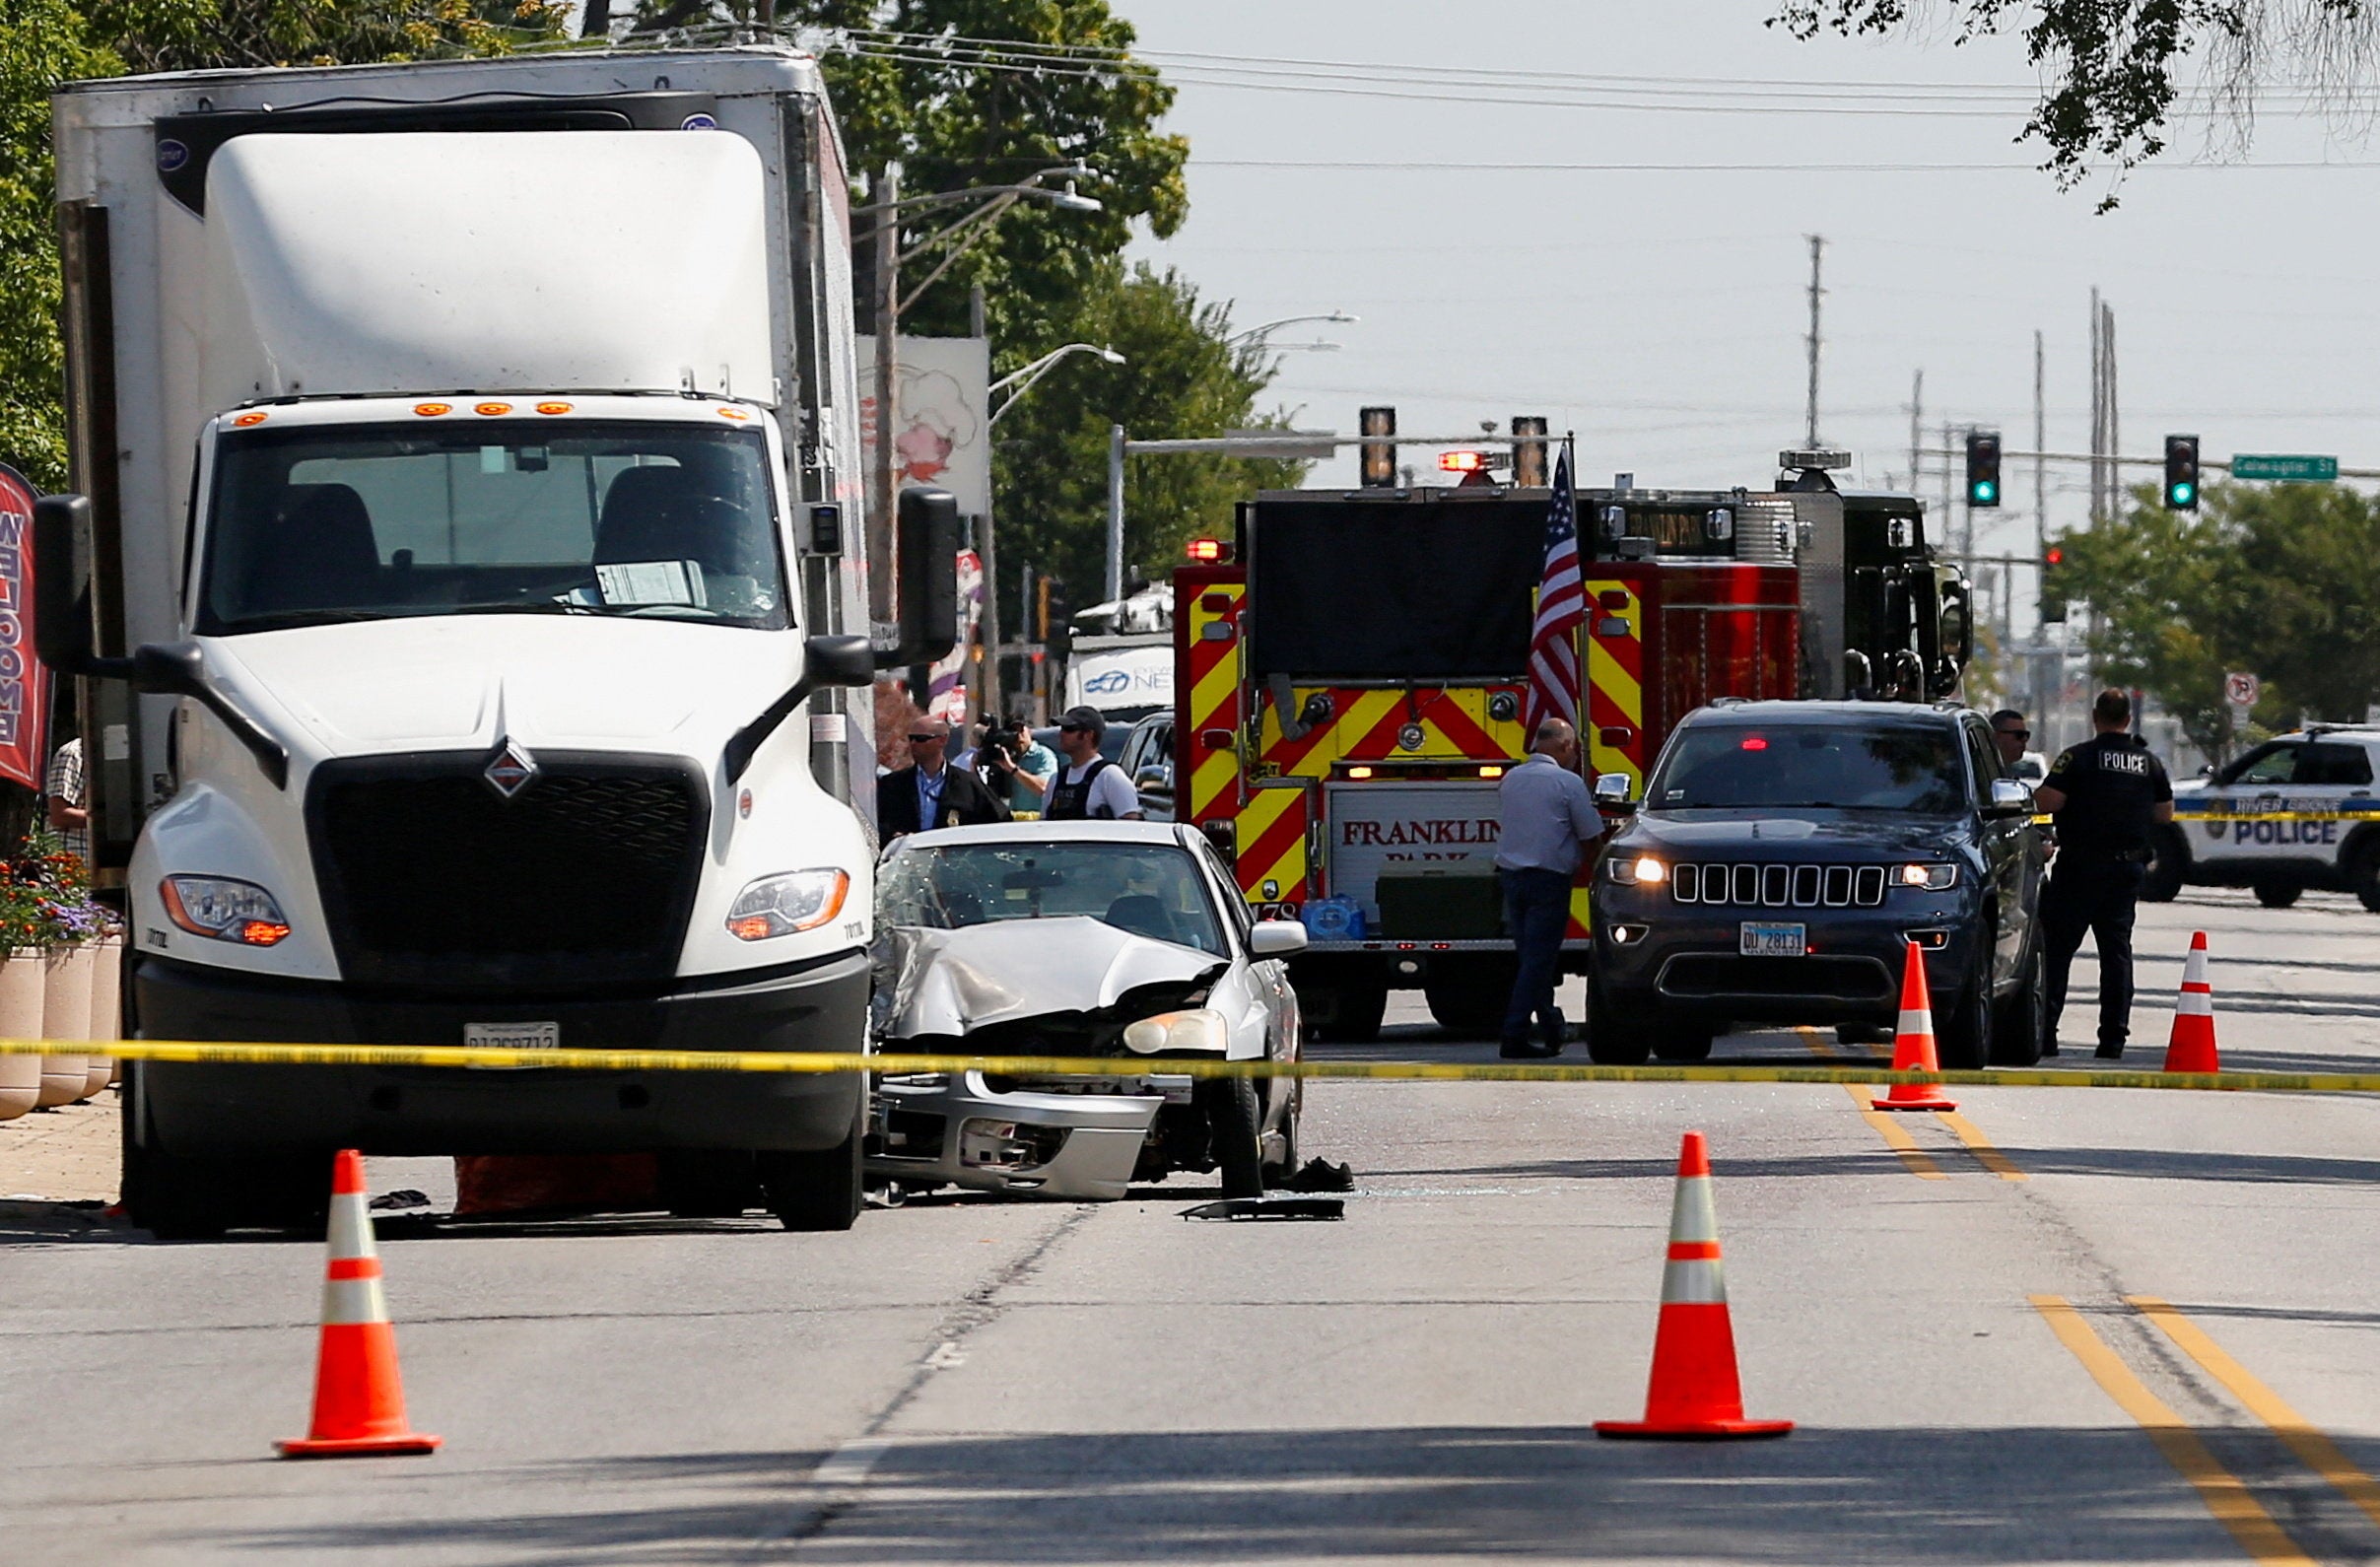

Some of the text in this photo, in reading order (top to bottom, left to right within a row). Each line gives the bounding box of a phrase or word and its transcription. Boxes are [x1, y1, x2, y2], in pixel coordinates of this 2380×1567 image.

[2104, 752, 2144, 774] POLICE
[2236, 797, 2282, 813] RIVER
[2233, 820, 2338, 846] POLICE
